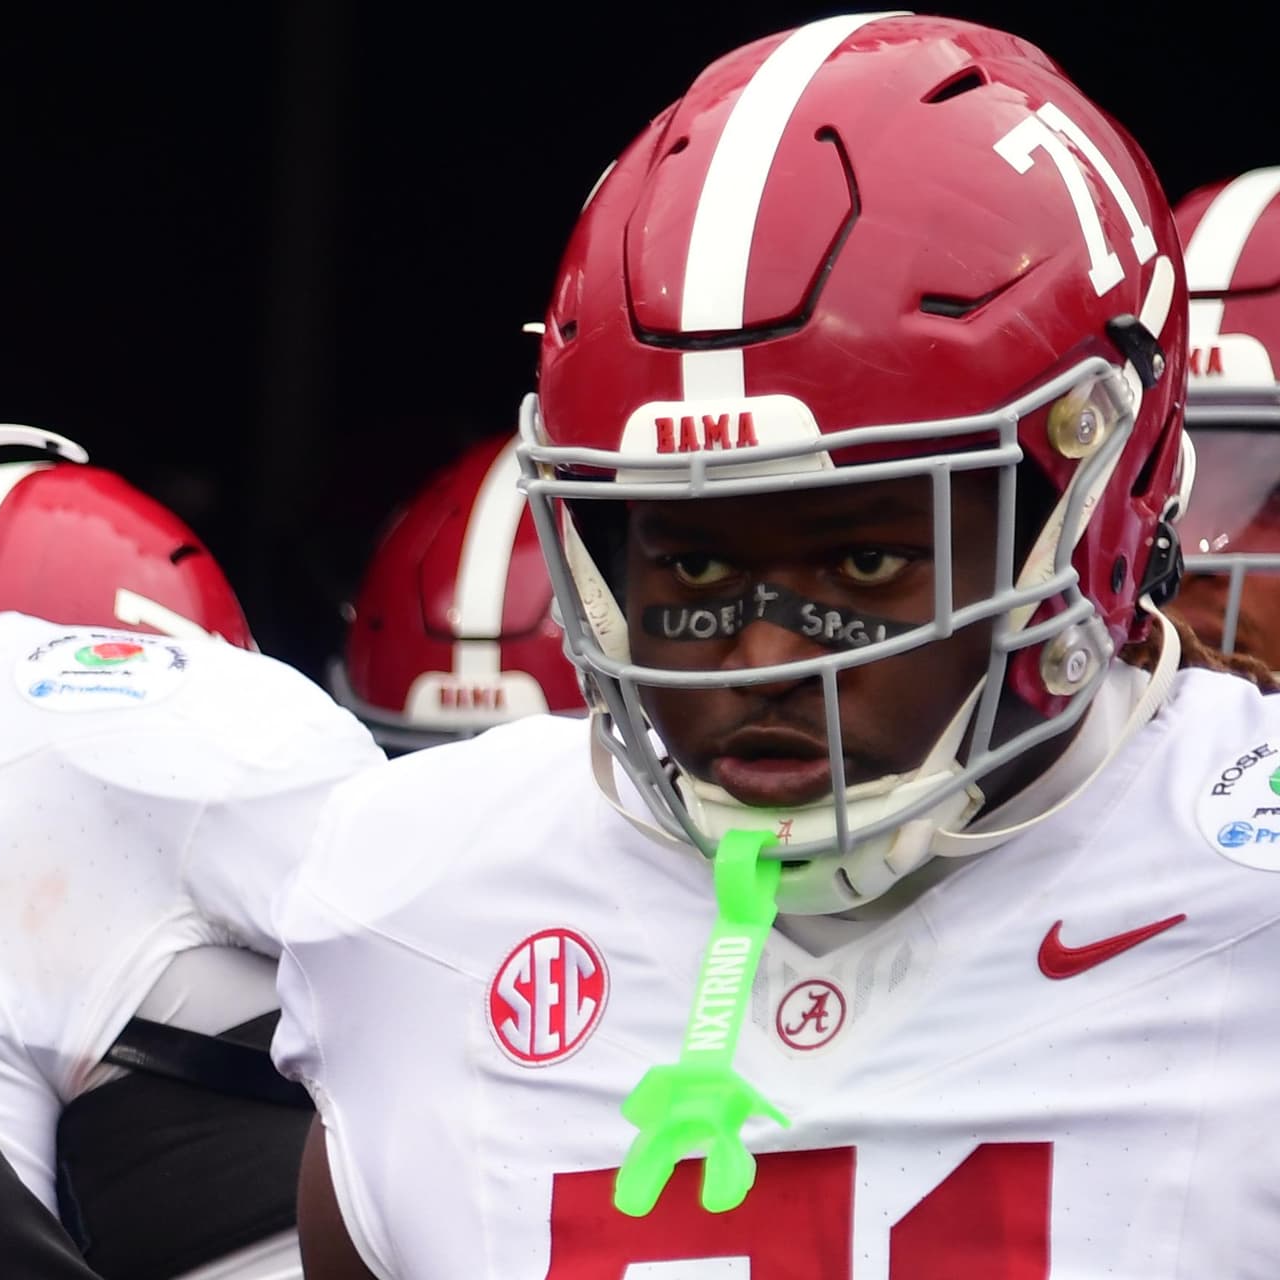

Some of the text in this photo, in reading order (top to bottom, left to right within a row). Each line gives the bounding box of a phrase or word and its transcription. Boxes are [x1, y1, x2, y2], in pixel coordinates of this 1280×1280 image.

[992, 101, 1159, 298] 71
[654, 411, 759, 455] BAMA
[1211, 743, 1278, 796] ROSE
[497, 935, 597, 1057] SEC
[687, 933, 753, 1053] NXTRND
